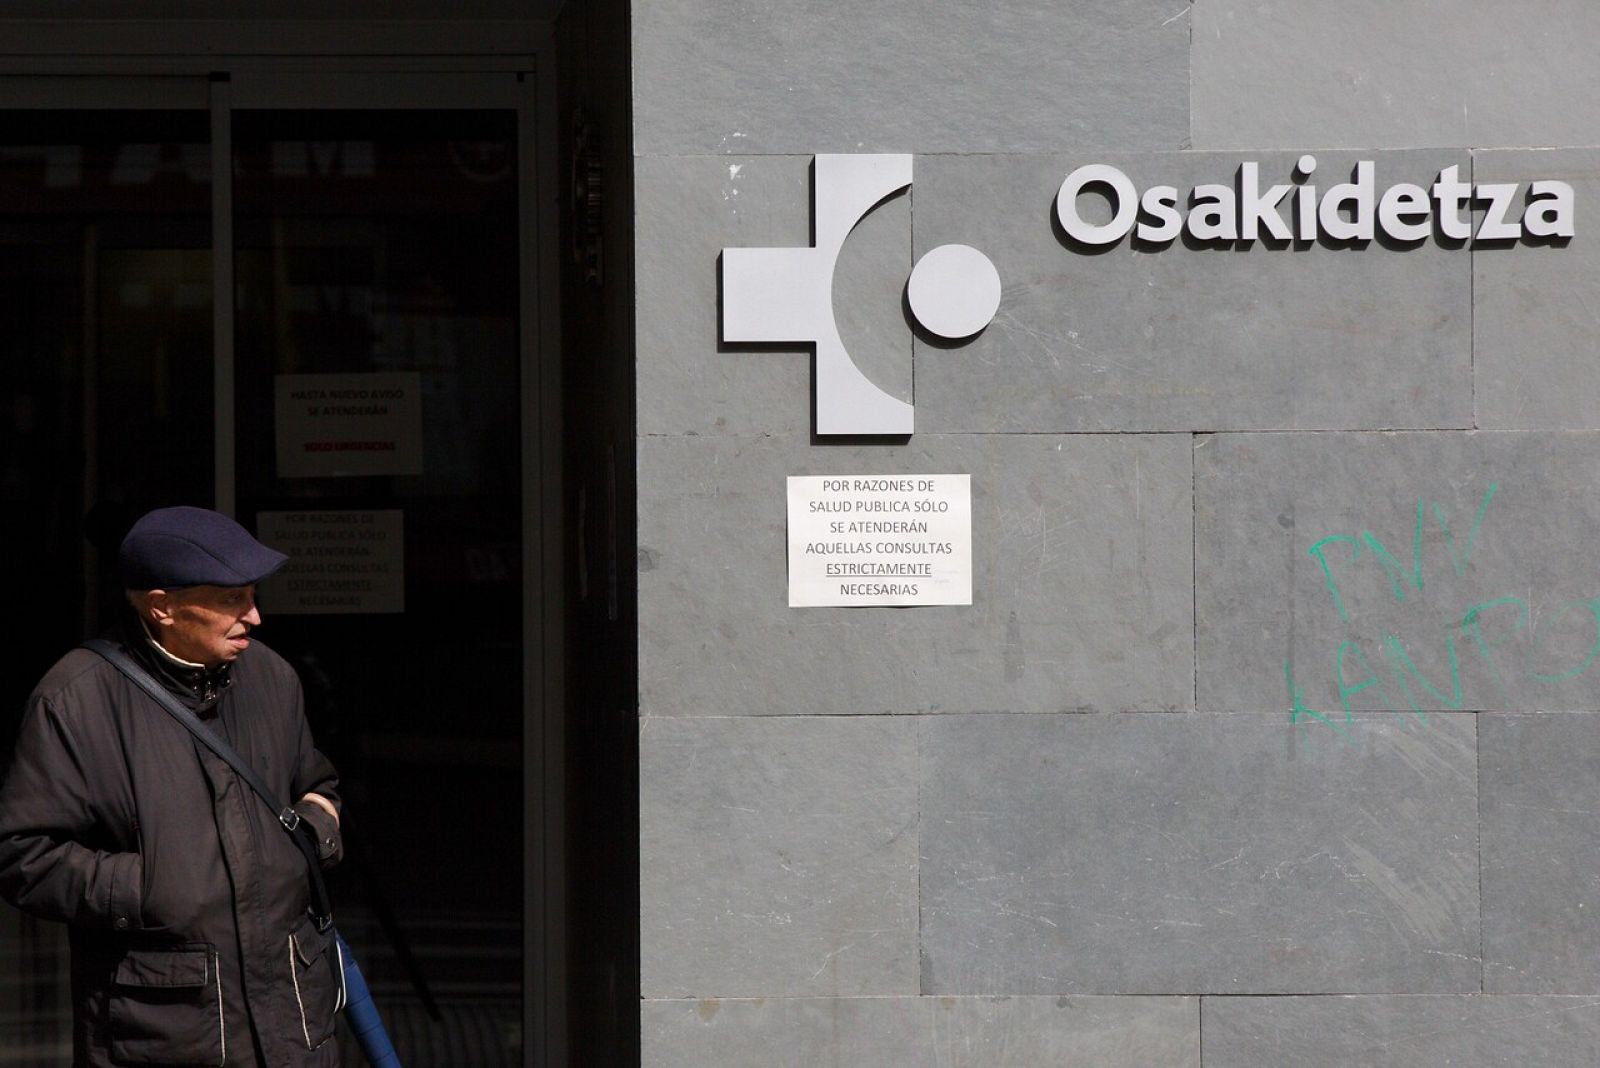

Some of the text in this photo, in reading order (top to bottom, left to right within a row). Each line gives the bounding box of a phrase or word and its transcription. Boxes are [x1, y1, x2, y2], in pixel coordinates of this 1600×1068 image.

[1055, 154, 1576, 244] Osakidetza
[291, 388, 405, 400] HASTA NUEVO AVISO
[307, 407, 318, 416] SE
[335, 441, 395, 452] URGENCIAS
[823, 480, 935, 492] POR RAZONES DE
[809, 498, 949, 513] SALUD PUBLICA SÓLO
[285, 514, 306, 523] POR
[309, 514, 358, 524] RAZONES
[829, 519, 928, 533] SE ATENDERÁN
[805, 542, 953, 555] AQUELLAS CONSULTAS
[826, 563, 932, 576] ESTRICTAMENTE
[840, 583, 919, 595] NECESARIAS
